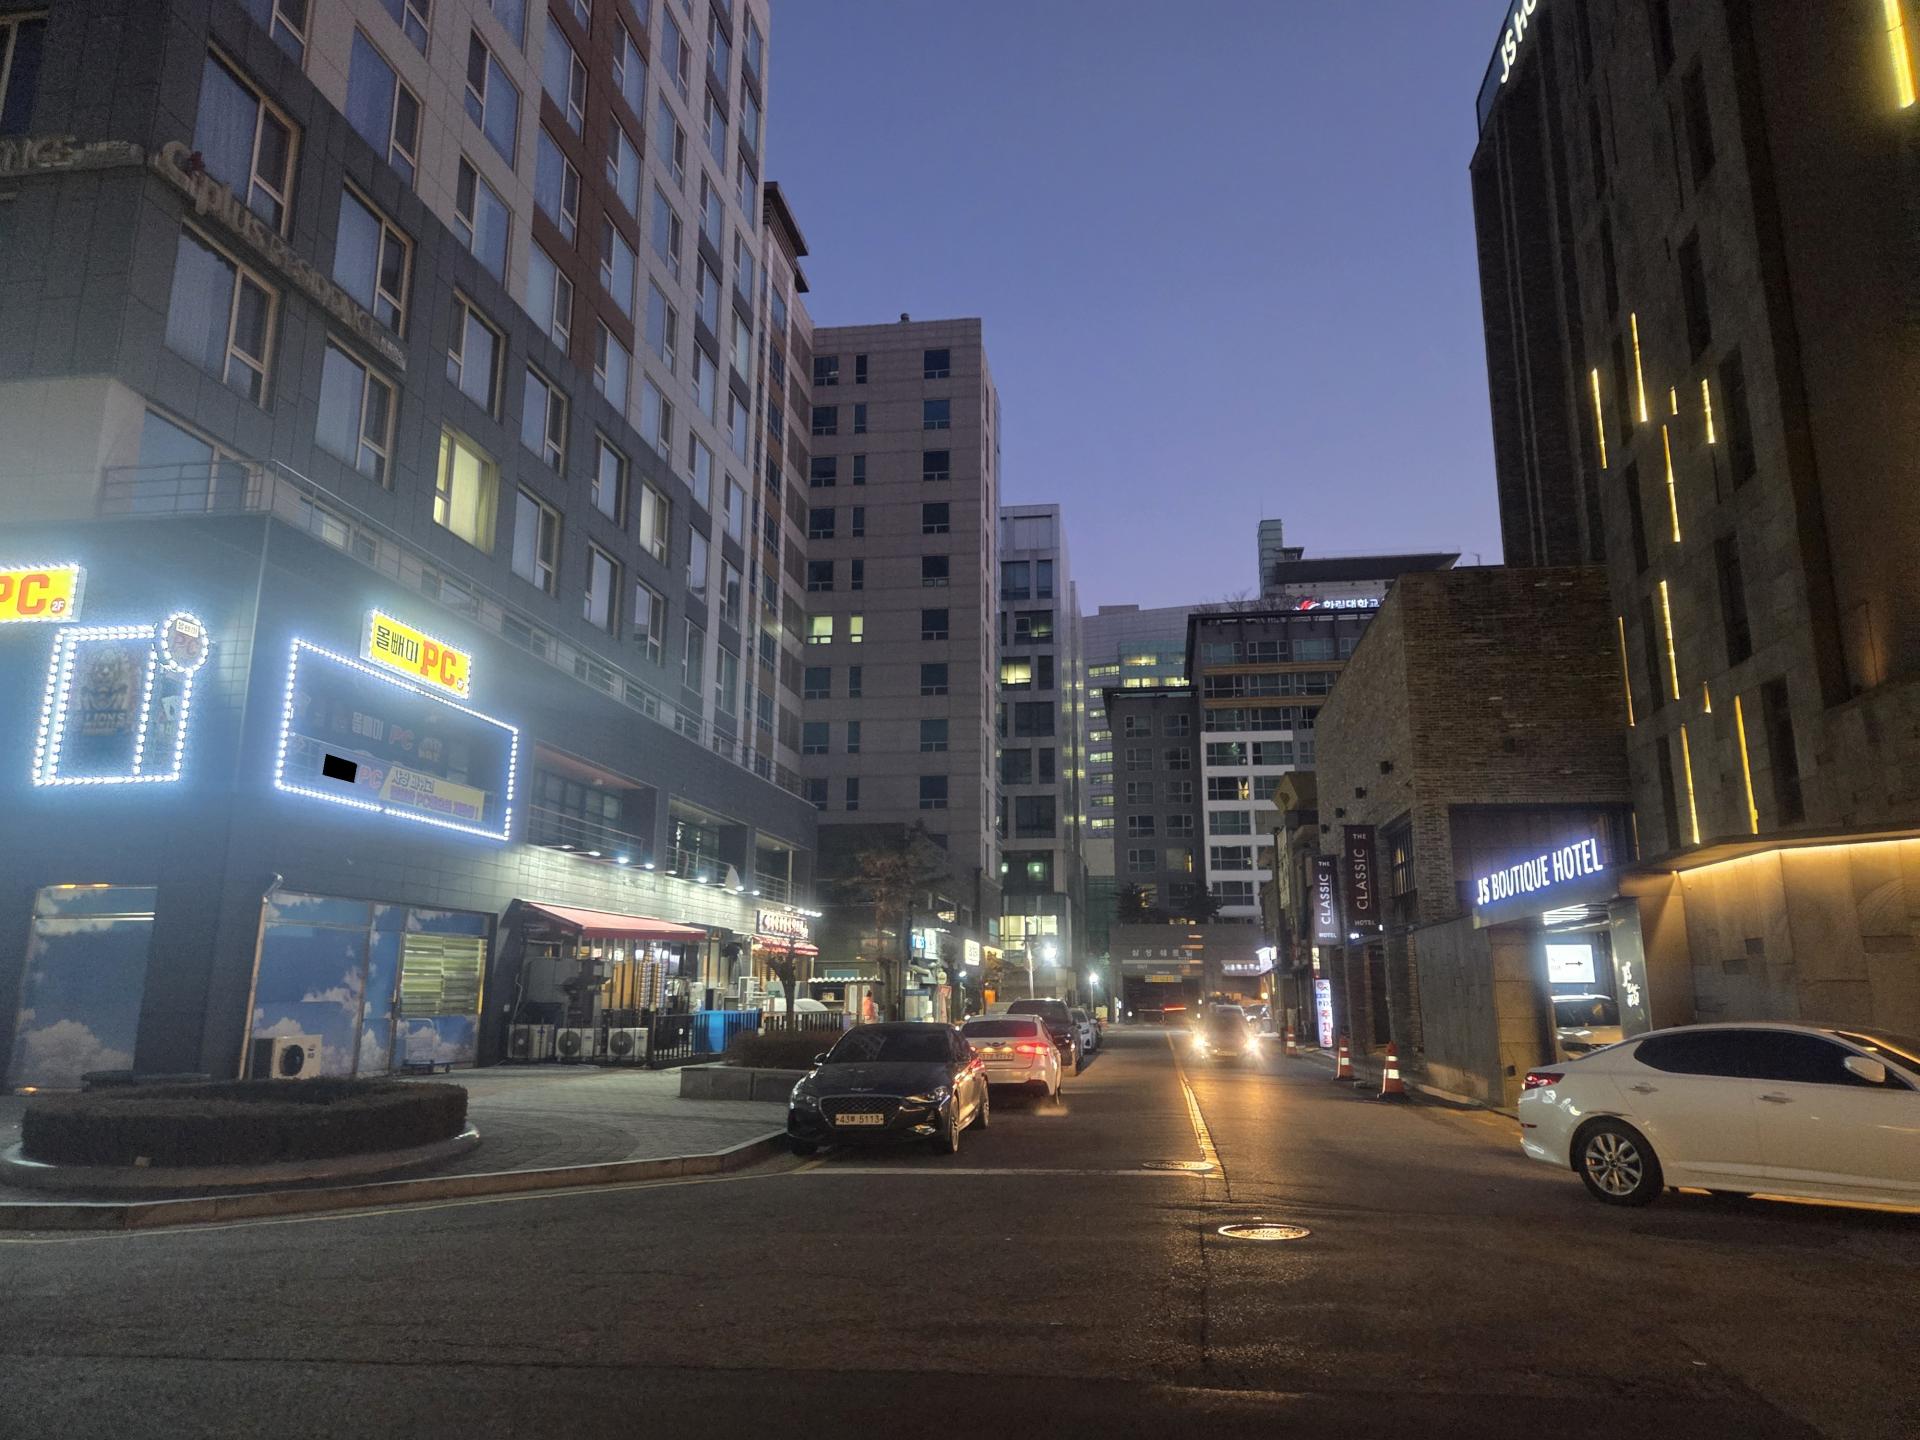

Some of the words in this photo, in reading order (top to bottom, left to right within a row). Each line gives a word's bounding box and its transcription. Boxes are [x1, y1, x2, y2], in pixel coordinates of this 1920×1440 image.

[420, 640, 456, 686] PC
[1353, 848, 1369, 910] CLASSIC
[1477, 879, 1490, 905] JS
[1492, 855, 1550, 901] BOUTIQUE
[1552, 838, 1603, 882] HOTEL
[1318, 874, 1331, 925] CLASSIC
[1354, 919, 1376, 927] HOTEL
